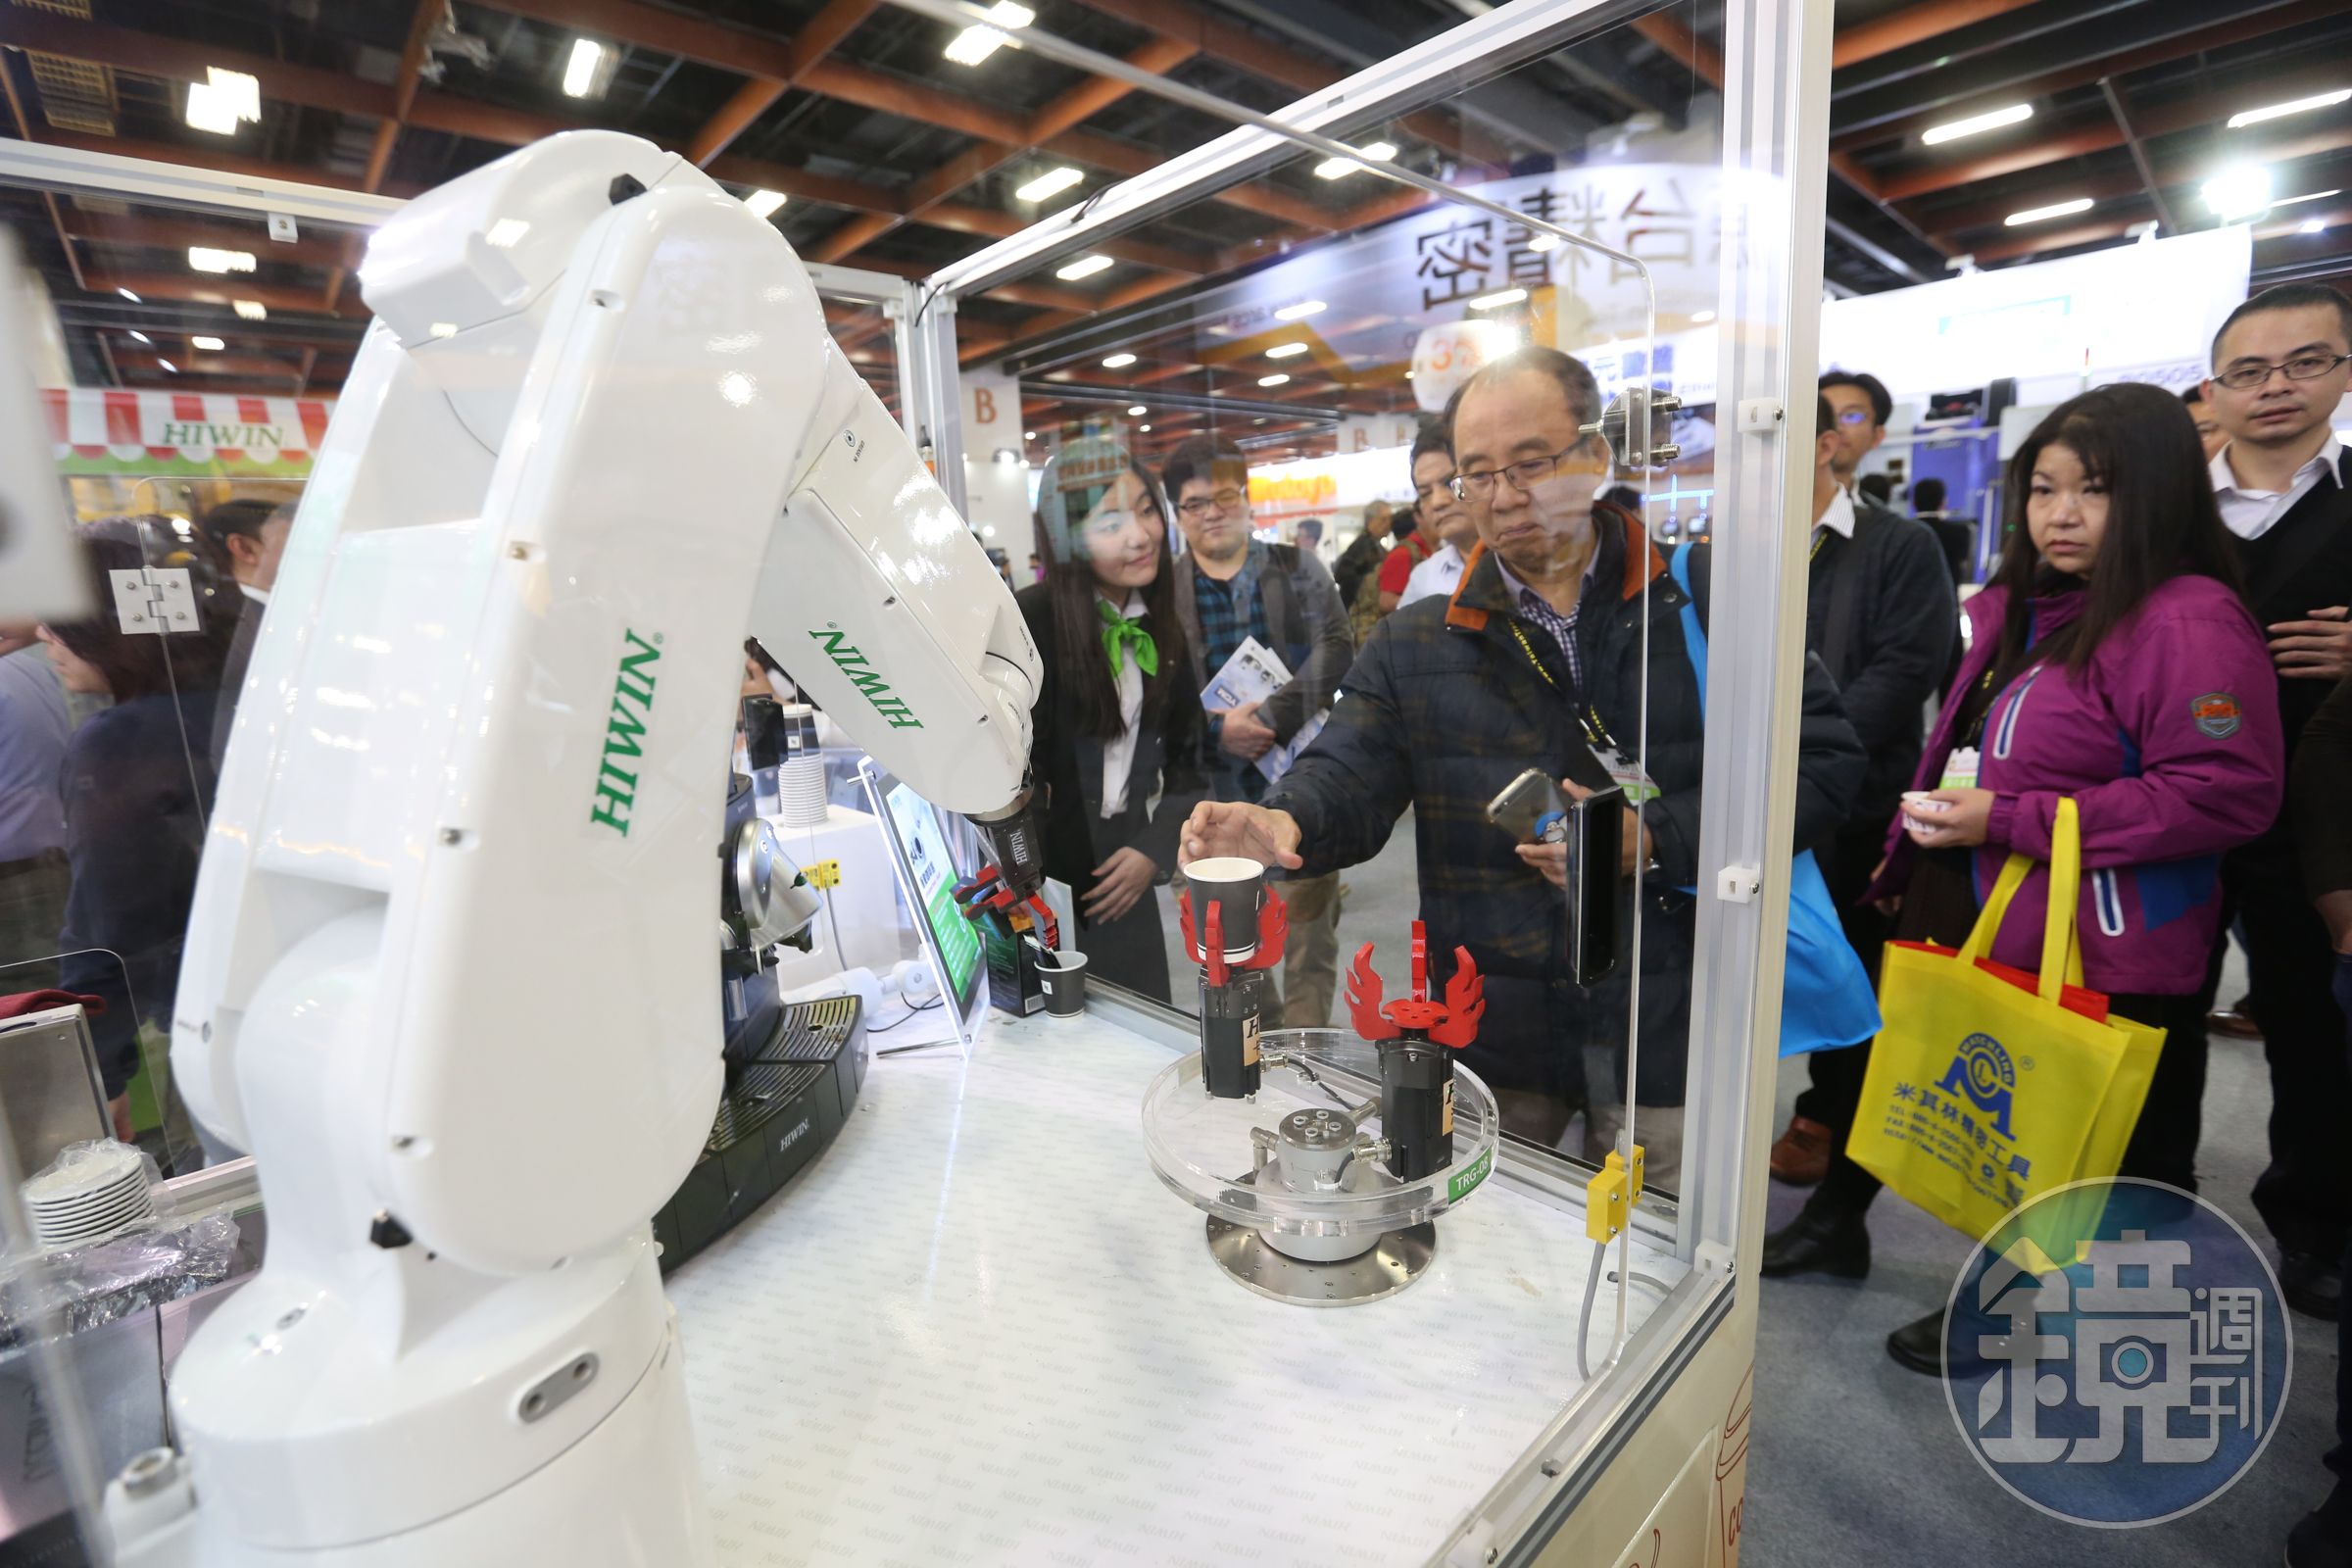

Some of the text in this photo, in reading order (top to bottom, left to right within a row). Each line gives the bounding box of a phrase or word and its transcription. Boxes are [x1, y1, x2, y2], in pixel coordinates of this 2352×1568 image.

[974, 388, 997, 424] B
[163, 422, 285, 449] HIWIN
[809, 629, 924, 729] HIWIN
[590, 628, 662, 838] HIWIN
[1010, 828, 1028, 866] HIWIN
[780, 1118, 809, 1152] HIWIN
[1455, 1155, 1489, 1192] TRG-08
